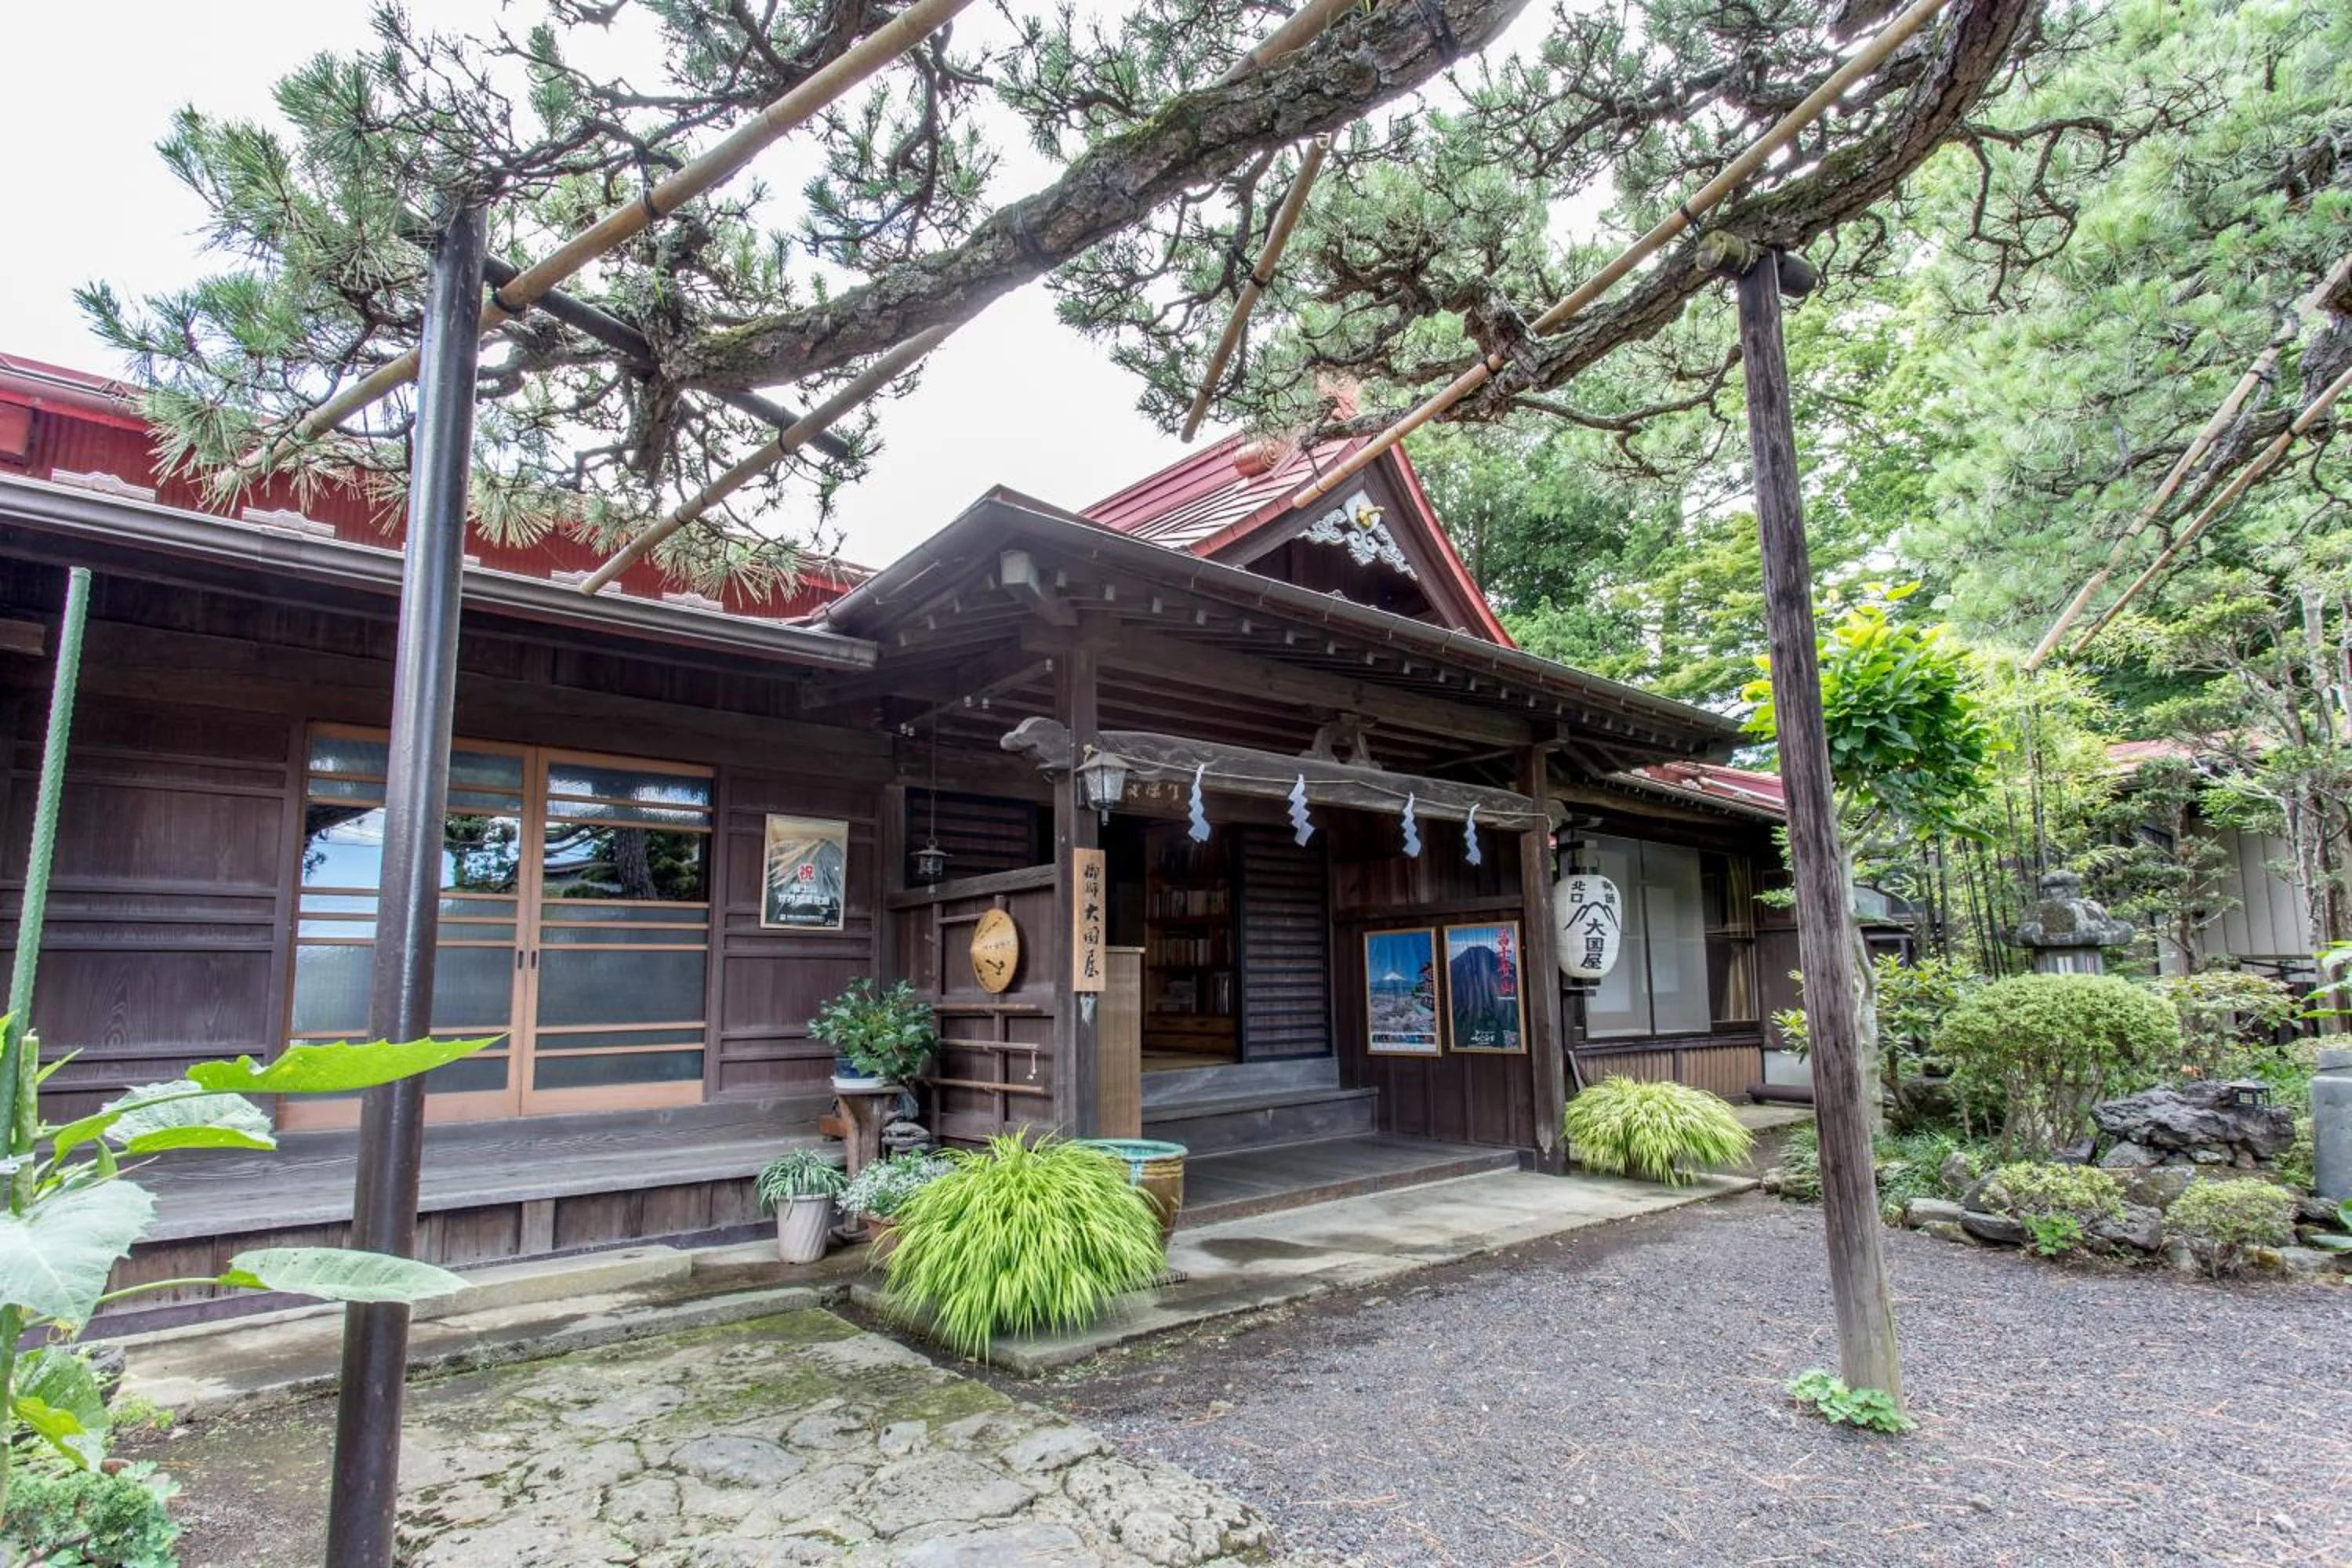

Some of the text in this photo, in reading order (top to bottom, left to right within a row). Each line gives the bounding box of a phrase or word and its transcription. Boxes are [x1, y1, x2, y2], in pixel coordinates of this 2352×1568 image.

[799, 865, 814, 880] 祝
[1571, 880, 1585, 903] 北口
[1581, 918, 1606, 969] 大国屋
